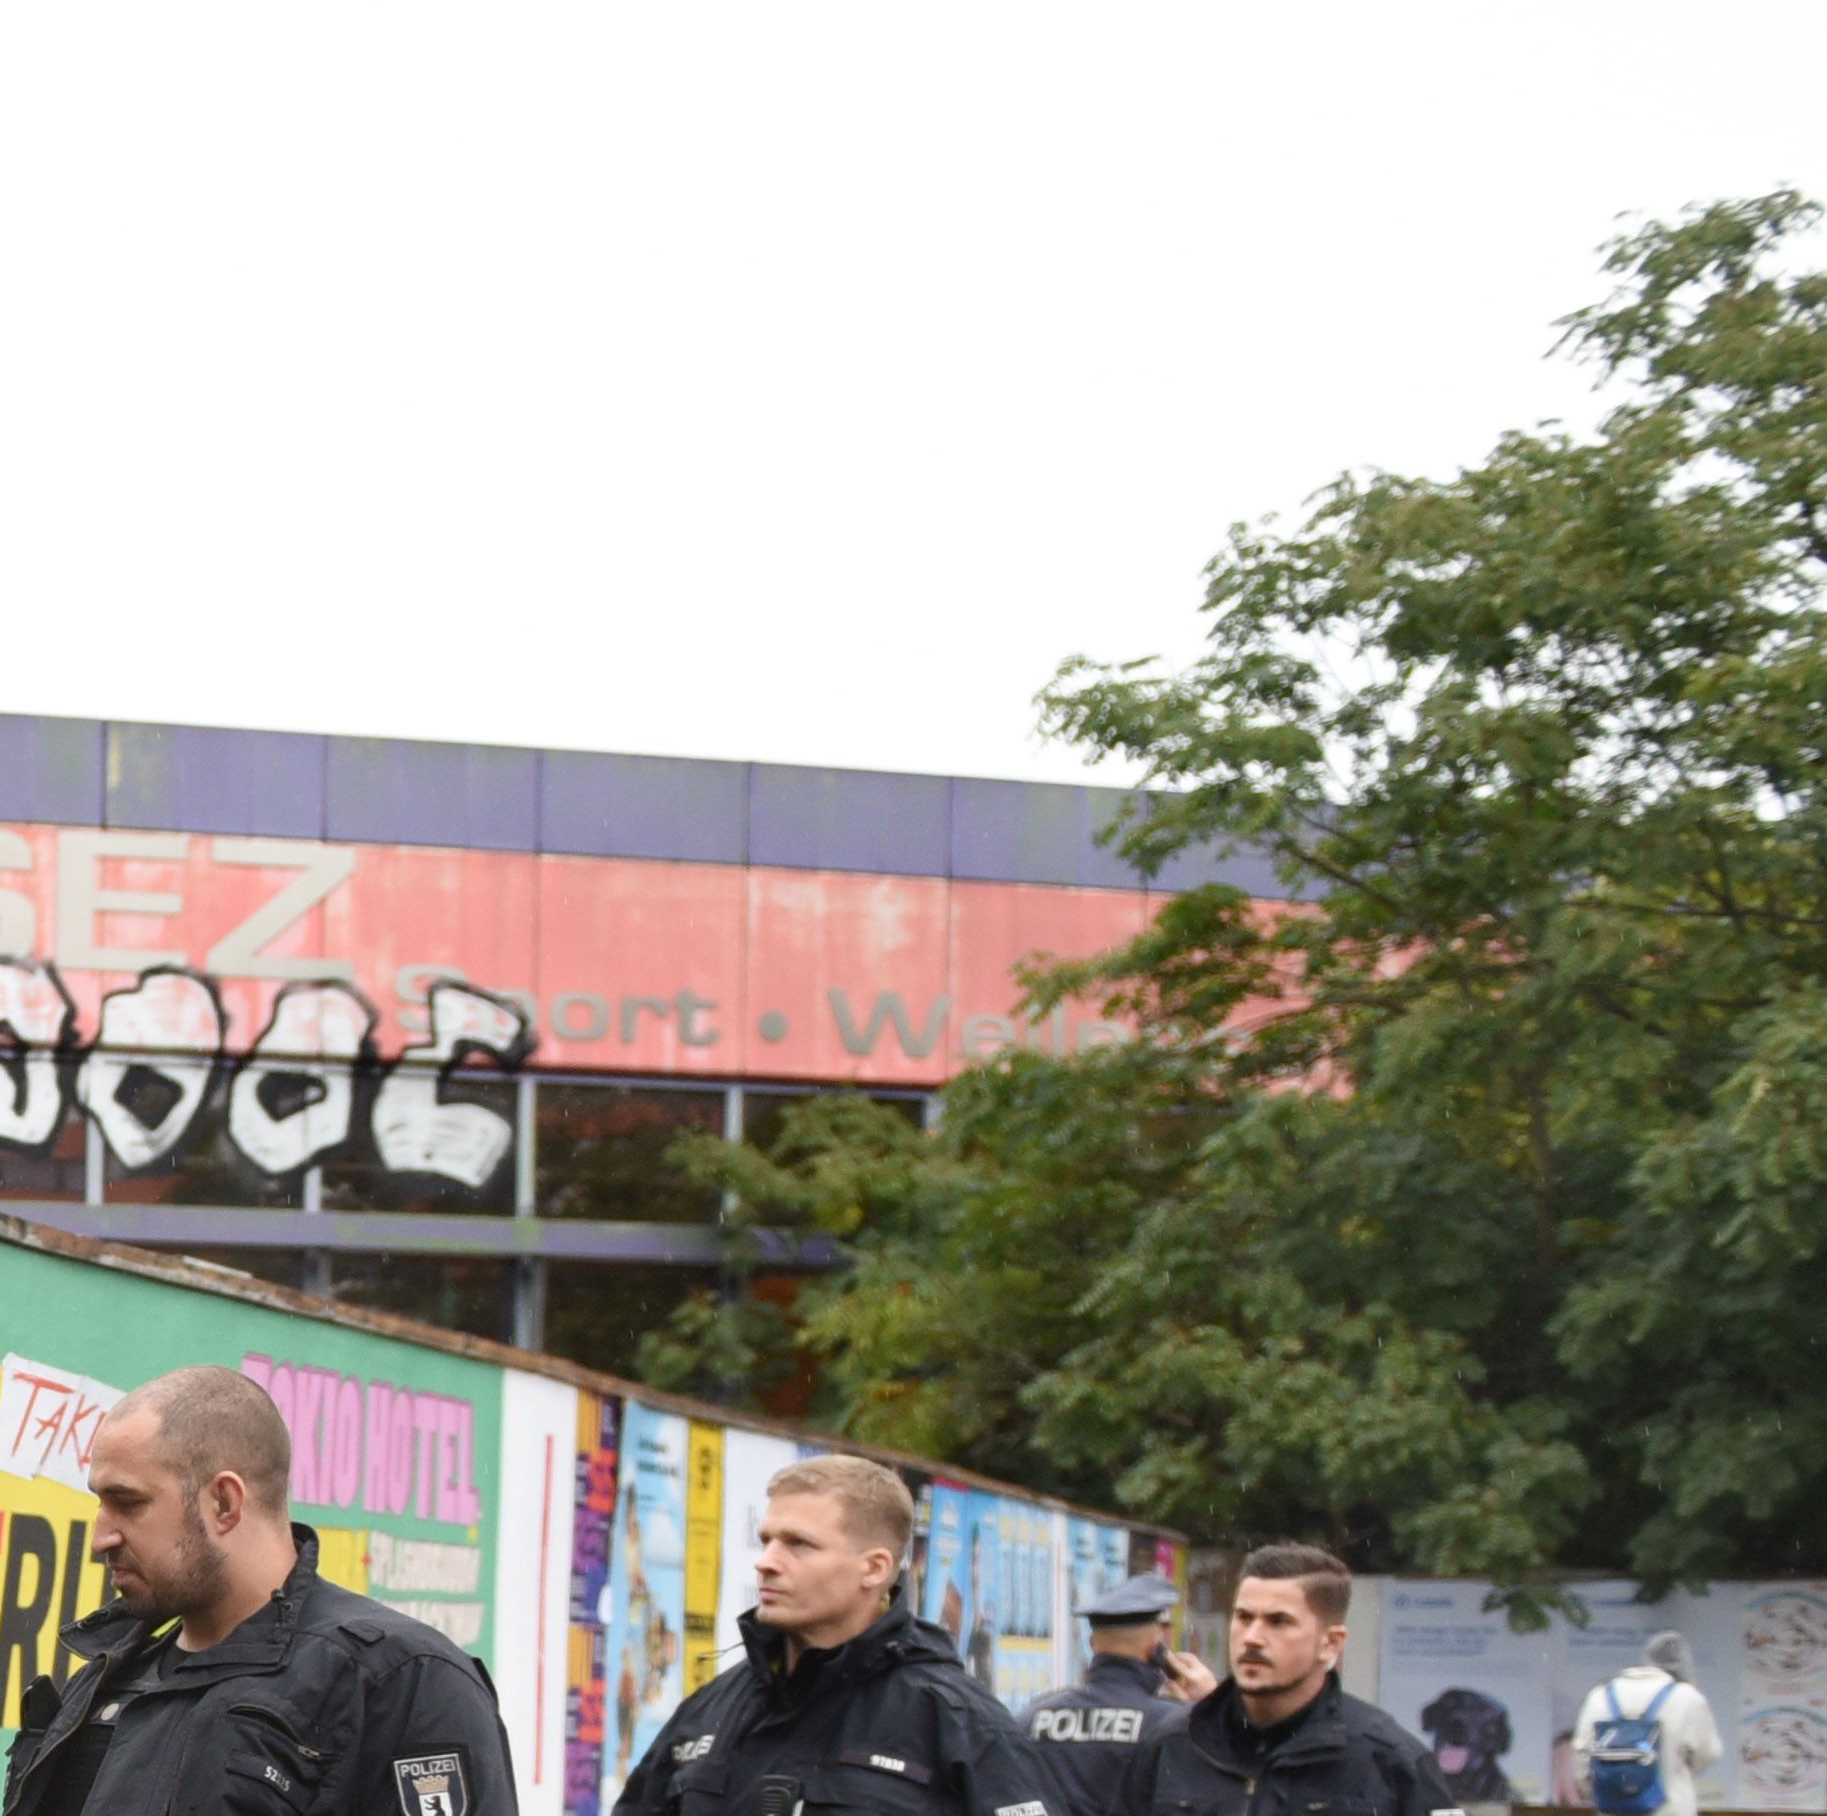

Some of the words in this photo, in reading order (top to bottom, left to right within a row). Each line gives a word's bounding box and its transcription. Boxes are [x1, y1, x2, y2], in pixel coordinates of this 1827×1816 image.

[394, 963, 722, 1046] Sort
[361, 1377, 480, 1526] HOTEL
[1032, 1707, 1144, 1743] POLIZEI
[399, 1758, 455, 1778] POLIZEI
